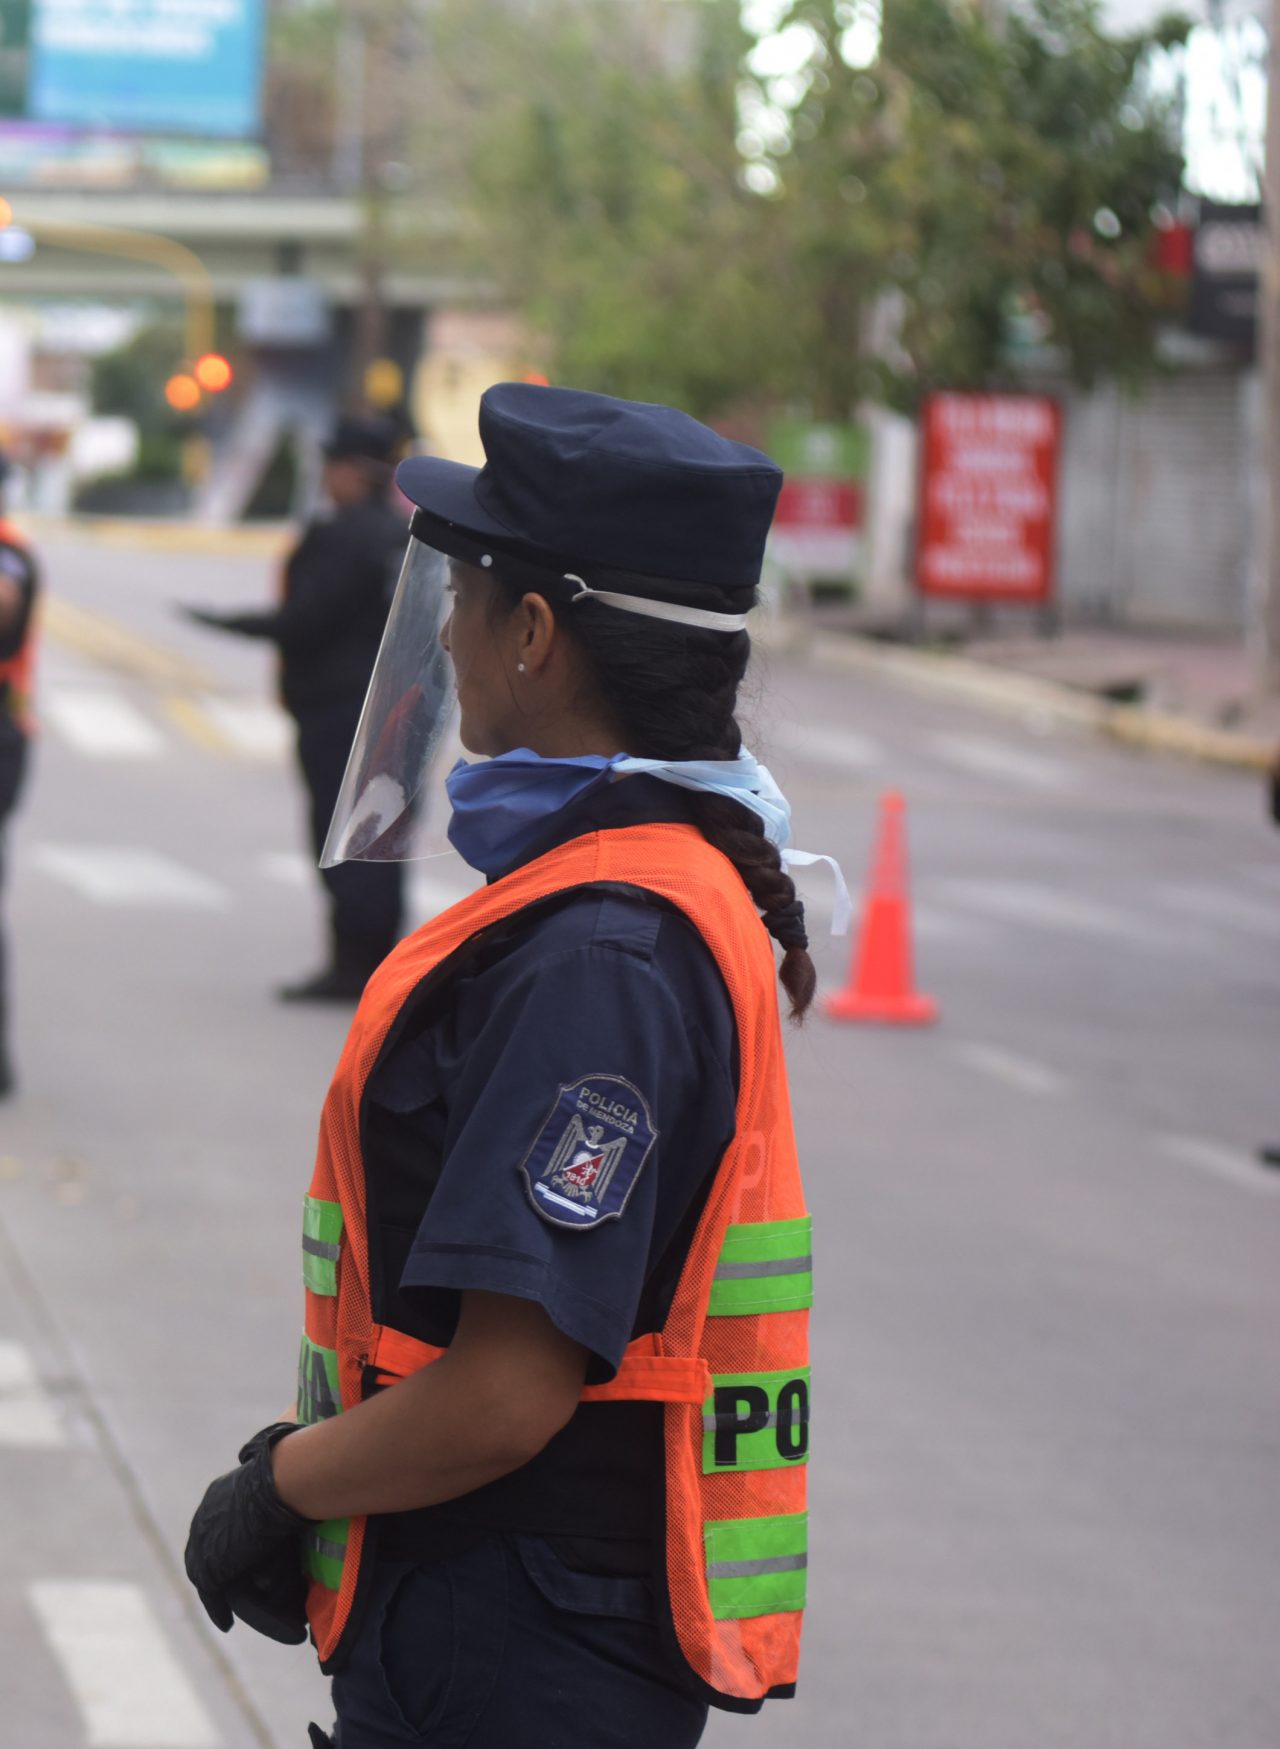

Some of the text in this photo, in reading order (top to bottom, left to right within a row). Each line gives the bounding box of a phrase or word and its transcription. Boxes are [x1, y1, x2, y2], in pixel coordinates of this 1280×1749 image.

[576, 1099, 634, 1134] DE MENDOZA
[579, 1087, 638, 1125] POLICIA
[297, 1343, 338, 1425] IA
[714, 1378, 810, 1467] PO
